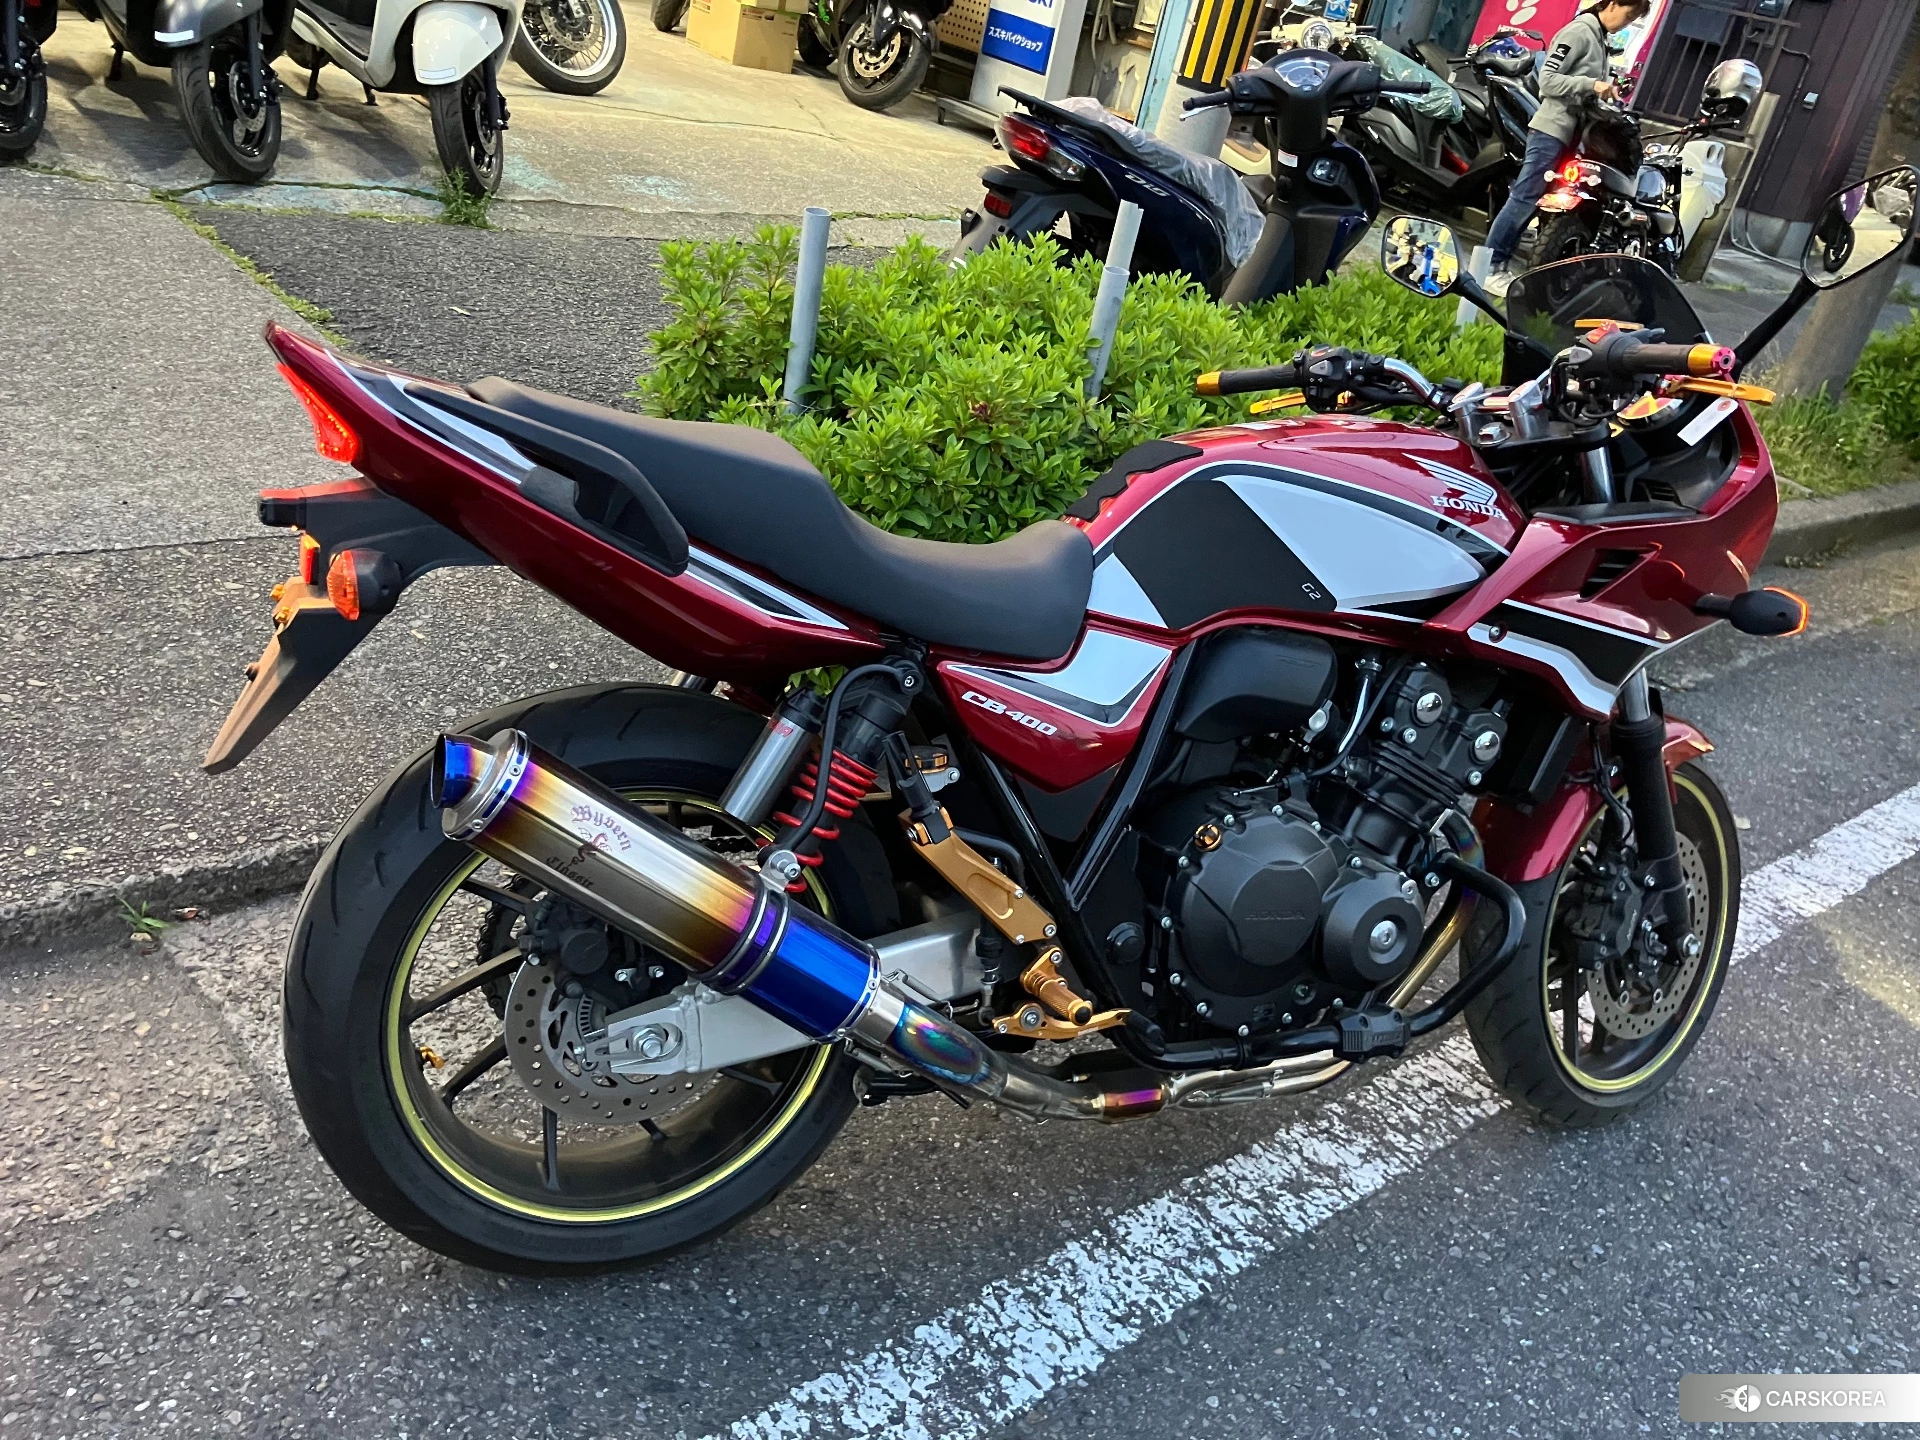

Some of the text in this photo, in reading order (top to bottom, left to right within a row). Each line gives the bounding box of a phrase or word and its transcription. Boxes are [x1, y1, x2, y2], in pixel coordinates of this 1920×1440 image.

[988, 26, 1043, 52] スズキバイクショップ
[1430, 495, 1509, 522] HONDA
[961, 690, 1058, 736] CB400
[570, 804, 632, 852] Wyvern
